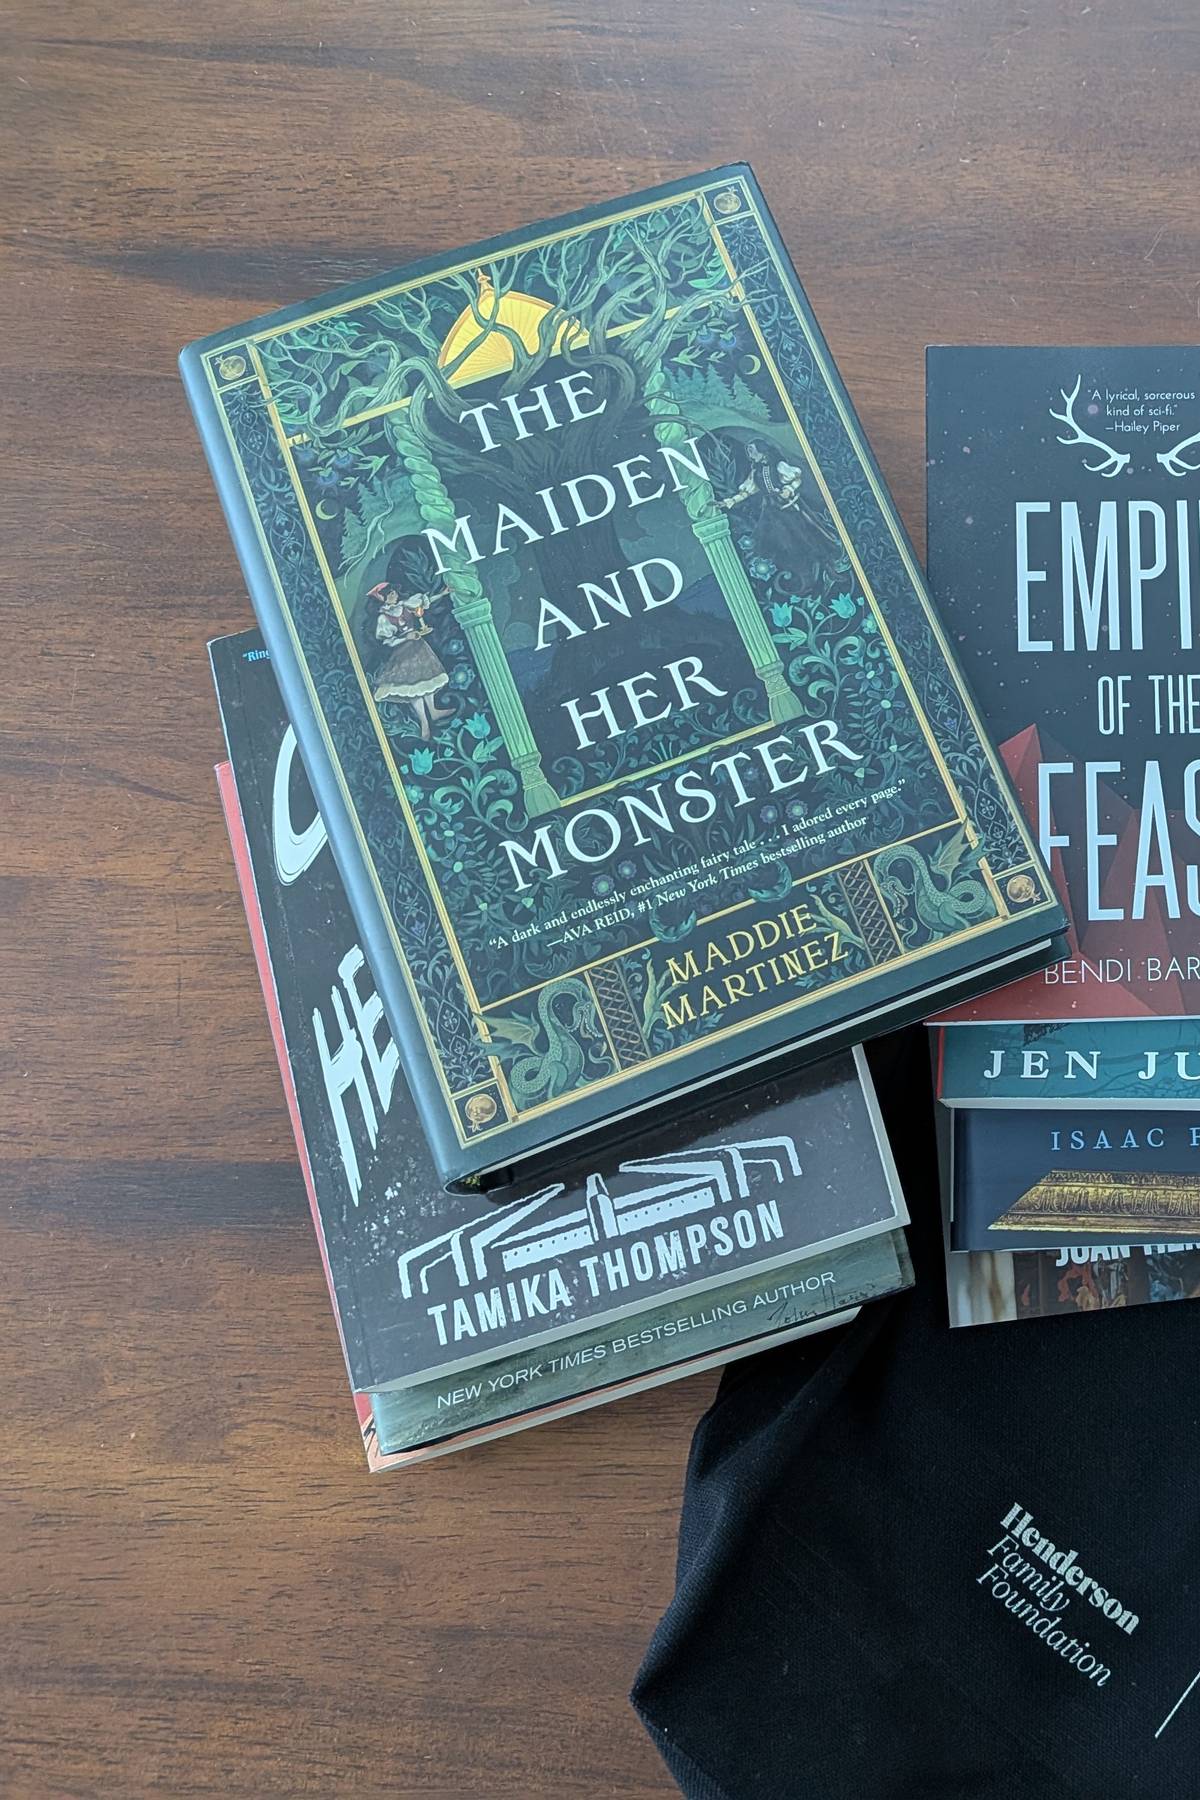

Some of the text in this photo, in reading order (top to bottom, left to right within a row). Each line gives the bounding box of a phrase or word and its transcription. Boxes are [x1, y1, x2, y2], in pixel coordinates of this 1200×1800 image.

[459, 370, 608, 452] THE
[1106, 388, 1140, 403] lyrical,
[1144, 391, 1196, 400] sorcerous
[1106, 404, 1130, 416] kind
[1133, 404, 1145, 416] of
[1153, 420, 1180, 435] Piper
[422, 436, 714, 574] MAIDEN
[534, 556, 684, 651] AND
[561, 655, 728, 751] HER
[1097, 675, 1132, 735] OF
[500, 719, 863, 892] MONSTER
[512, 923, 541, 945] dark
[544, 912, 568, 933] and
[570, 890, 628, 926] endlessly
[630, 865, 700, 897] enchanting
[701, 844, 731, 871] fairy
[734, 839, 757, 859] tale
[783, 824, 791, 837] I
[790, 806, 833, 834] adored
[836, 797, 868, 822] every
[595, 908, 635, 932] REID,
[637, 899, 653, 913] #1
[655, 885, 686, 906] New
[687, 872, 718, 894] York
[719, 858, 759, 880] Times
[762, 832, 825, 865] bestselling
[827, 815, 868, 840] author
[661, 932, 851, 1030] MARTINEZ
[664, 904, 819, 987] MADDIE
[1045, 959, 1131, 984] BENDI
[983, 1050, 1102, 1080] JEN
[1051, 1127, 1166, 1151] ISAAC
[427, 1200, 784, 1346] TAMIKA THOMPSON
[437, 1382, 483, 1409] NEW
[488, 1365, 543, 1391] YORK
[548, 1345, 607, 1374] TIMES
[612, 1300, 747, 1354] BESTSELLING
[751, 1270, 837, 1308] AUTHOR
[987, 1534, 1070, 1611] Family
[1000, 1502, 1140, 1635] Henderson
[976, 1563, 1111, 1686] Foundation
